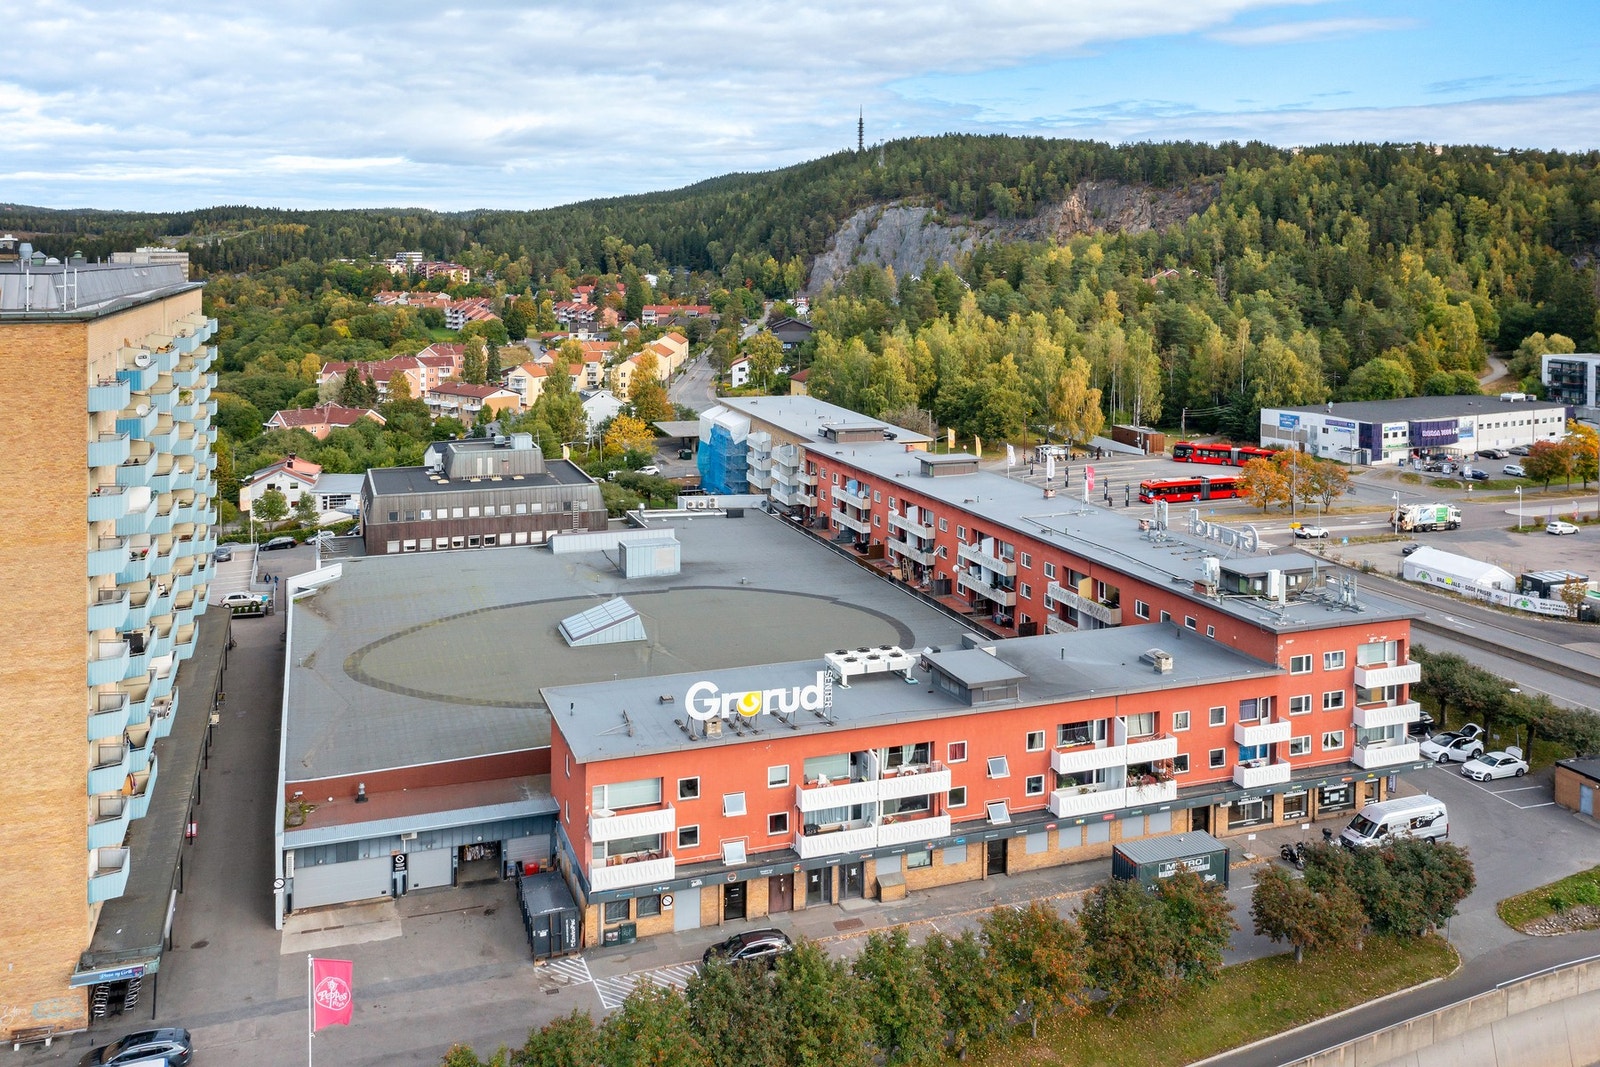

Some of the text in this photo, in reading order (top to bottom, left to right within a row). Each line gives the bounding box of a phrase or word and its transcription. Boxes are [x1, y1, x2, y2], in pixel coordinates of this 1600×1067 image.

[685, 671, 825, 720] Grorud
[825, 670, 833, 708] SENTER
[1166, 858, 1203, 871] MTRO
